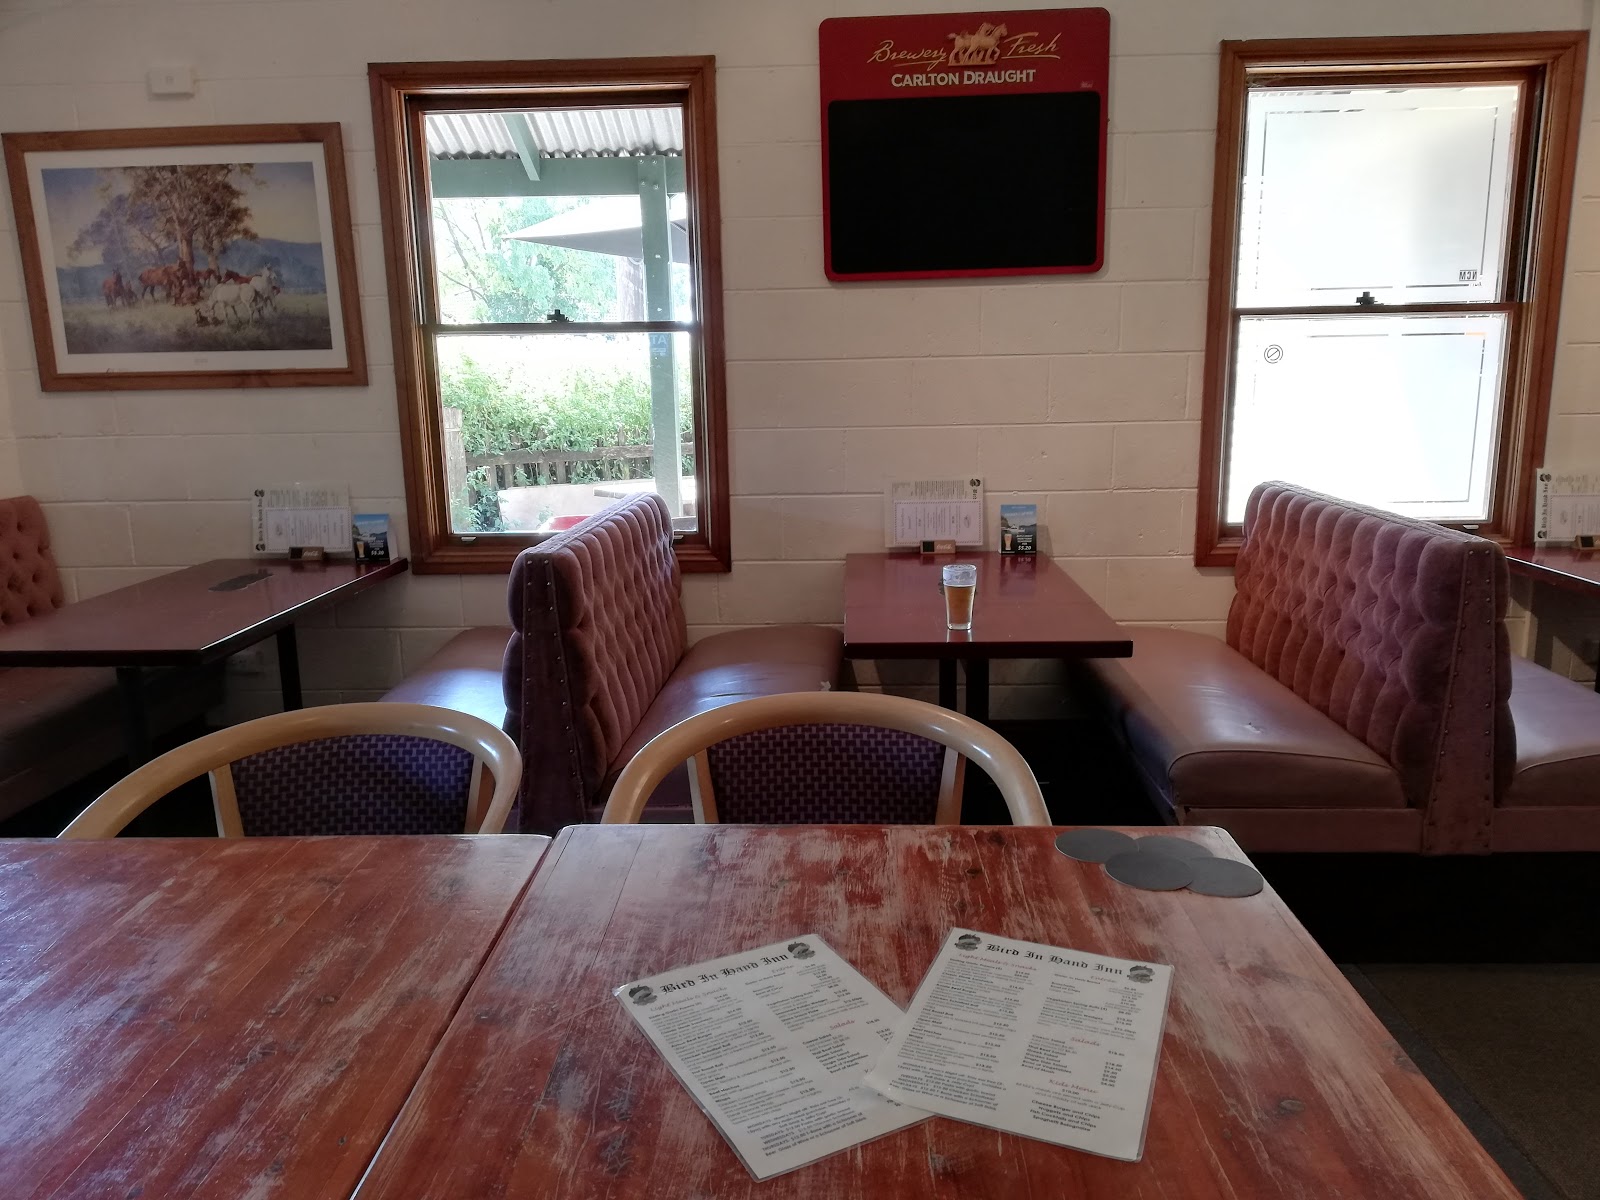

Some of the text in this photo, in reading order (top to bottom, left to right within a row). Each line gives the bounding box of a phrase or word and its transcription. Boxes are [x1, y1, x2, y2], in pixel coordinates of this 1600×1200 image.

[866, 32, 1062, 71] Brewery Fresh
[891, 69, 1036, 87] CARLTON DRAUGHT
[660, 954, 789, 995] Bird In Hand Inn
[986, 944, 1122, 974] Bird In Hand Inn
